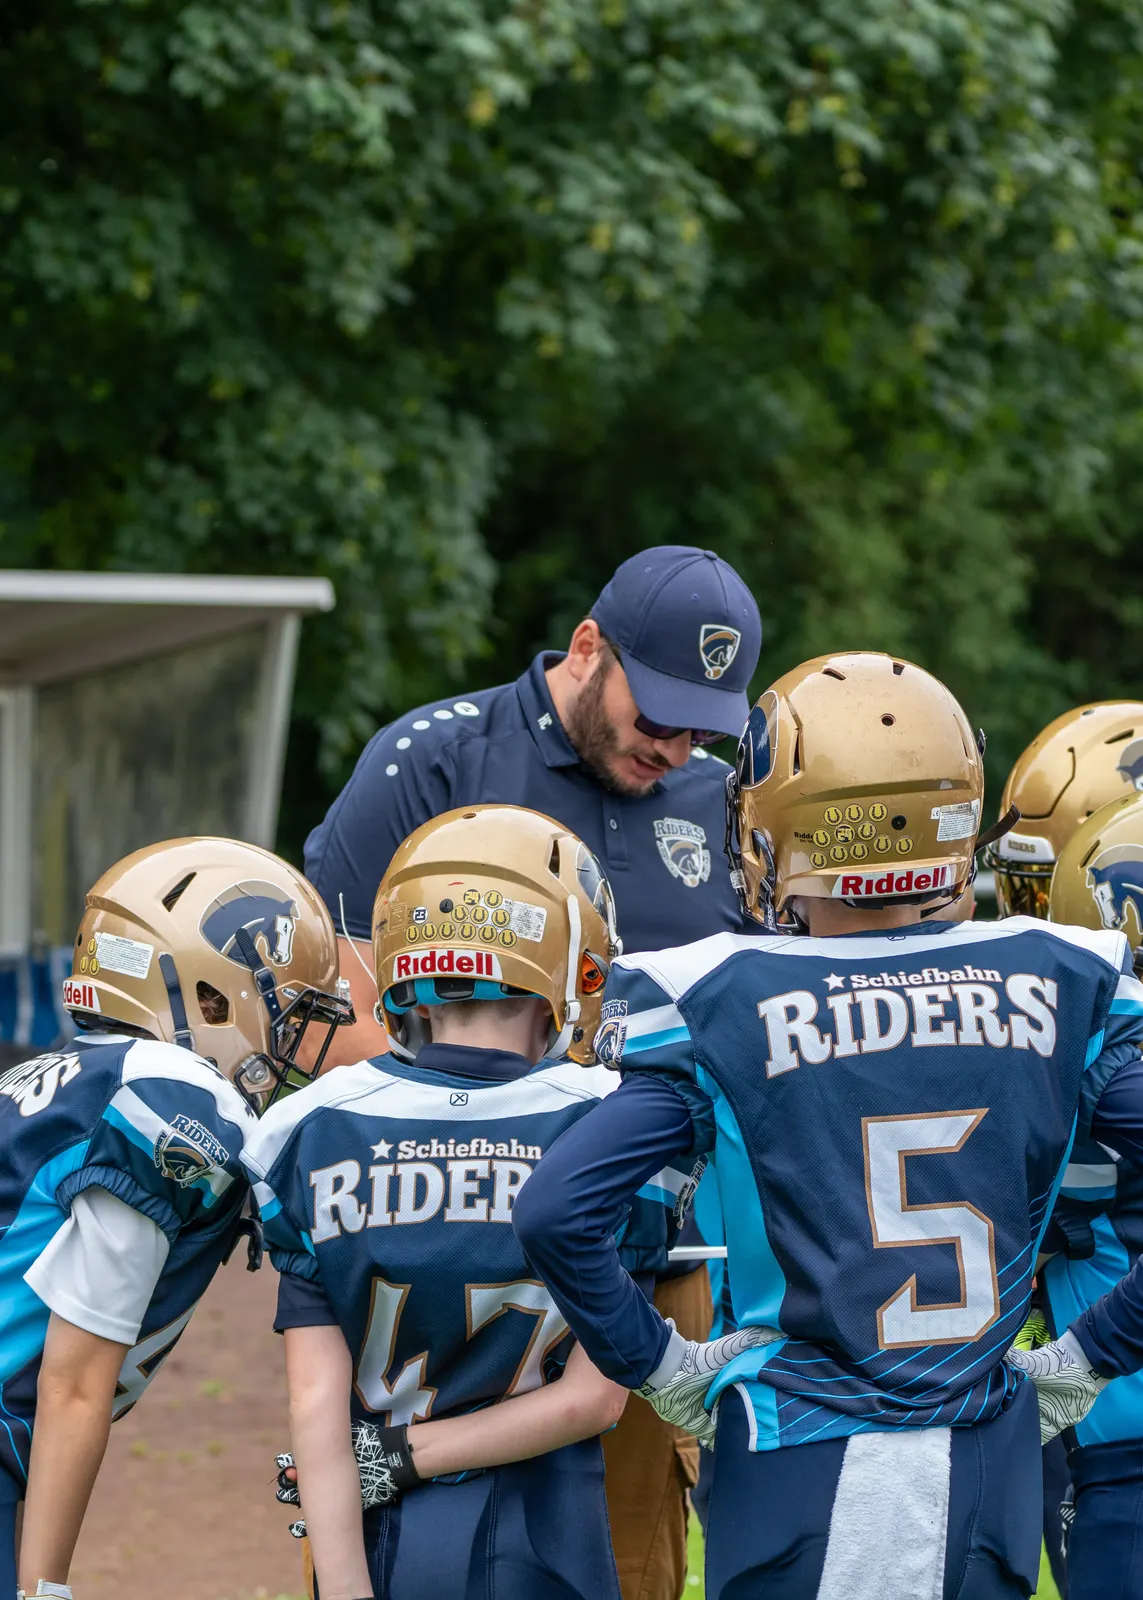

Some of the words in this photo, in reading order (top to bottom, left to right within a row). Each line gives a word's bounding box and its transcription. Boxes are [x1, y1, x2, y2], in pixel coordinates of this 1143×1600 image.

[655, 821, 705, 842] RIDERS
[841, 866, 947, 896] Riddell
[396, 950, 494, 979] Riddell
[851, 965, 1003, 989] Schiefbahn
[757, 973, 1058, 1080] RIDERS
[170, 1115, 229, 1167] RIDERS
[397, 1138, 542, 1160] Schiefbahn
[309, 1159, 534, 1245] RIDER
[861, 1107, 1000, 1350] 5
[353, 1276, 572, 1428] 47
